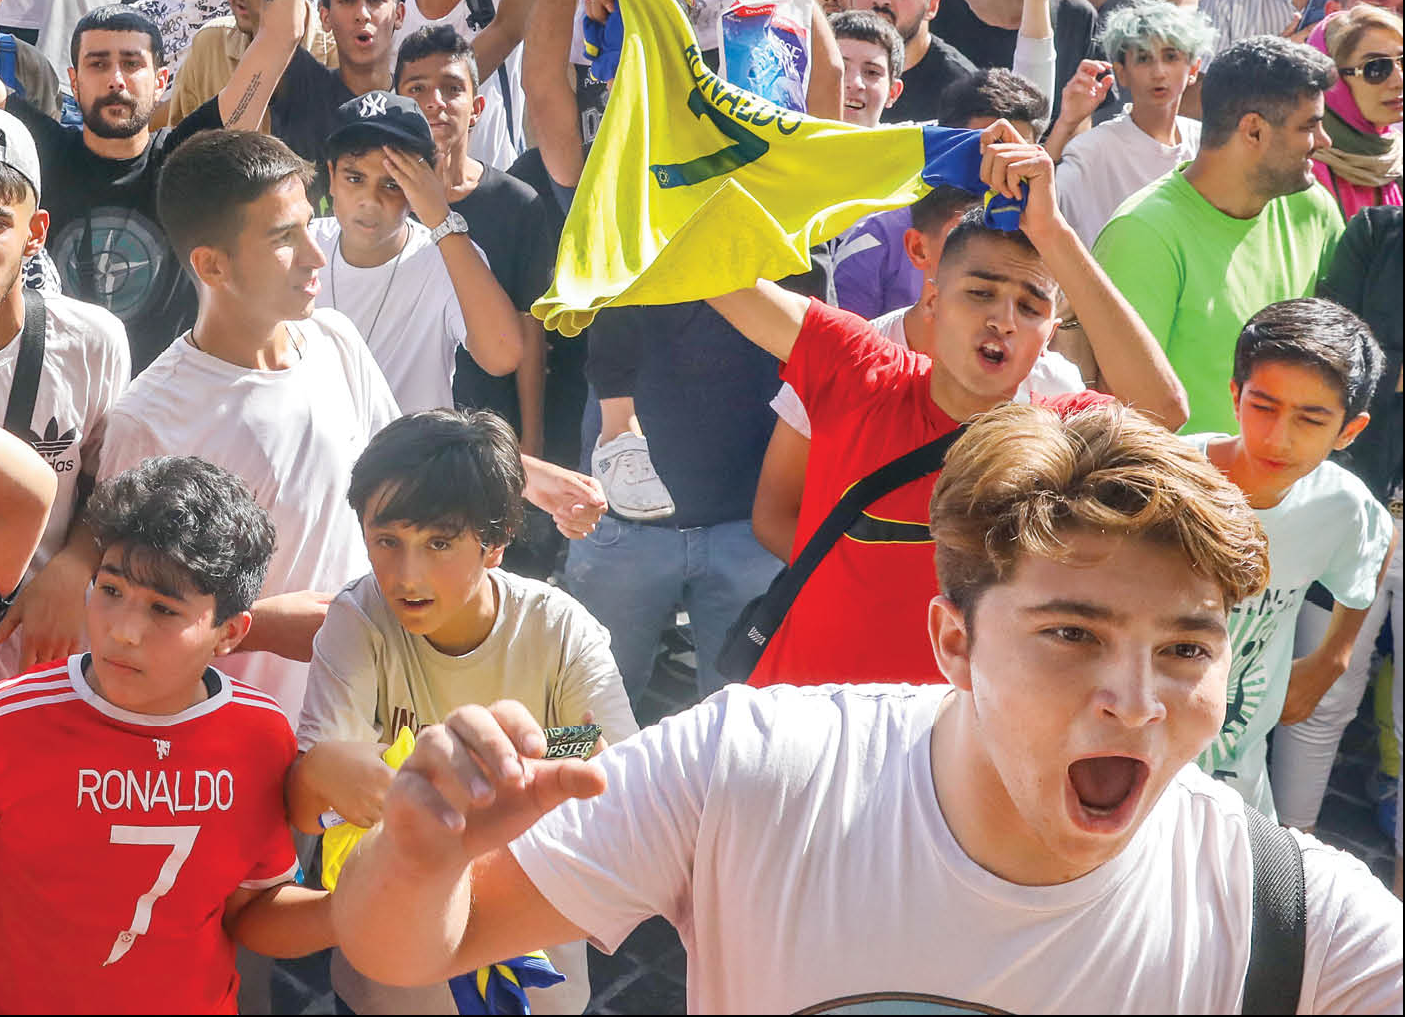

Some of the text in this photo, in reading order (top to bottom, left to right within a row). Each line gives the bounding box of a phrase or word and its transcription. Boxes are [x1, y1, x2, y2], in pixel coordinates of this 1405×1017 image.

[649, 86, 770, 189] 7
[77, 768, 234, 817] RONALDO
[102, 824, 201, 967] 7
